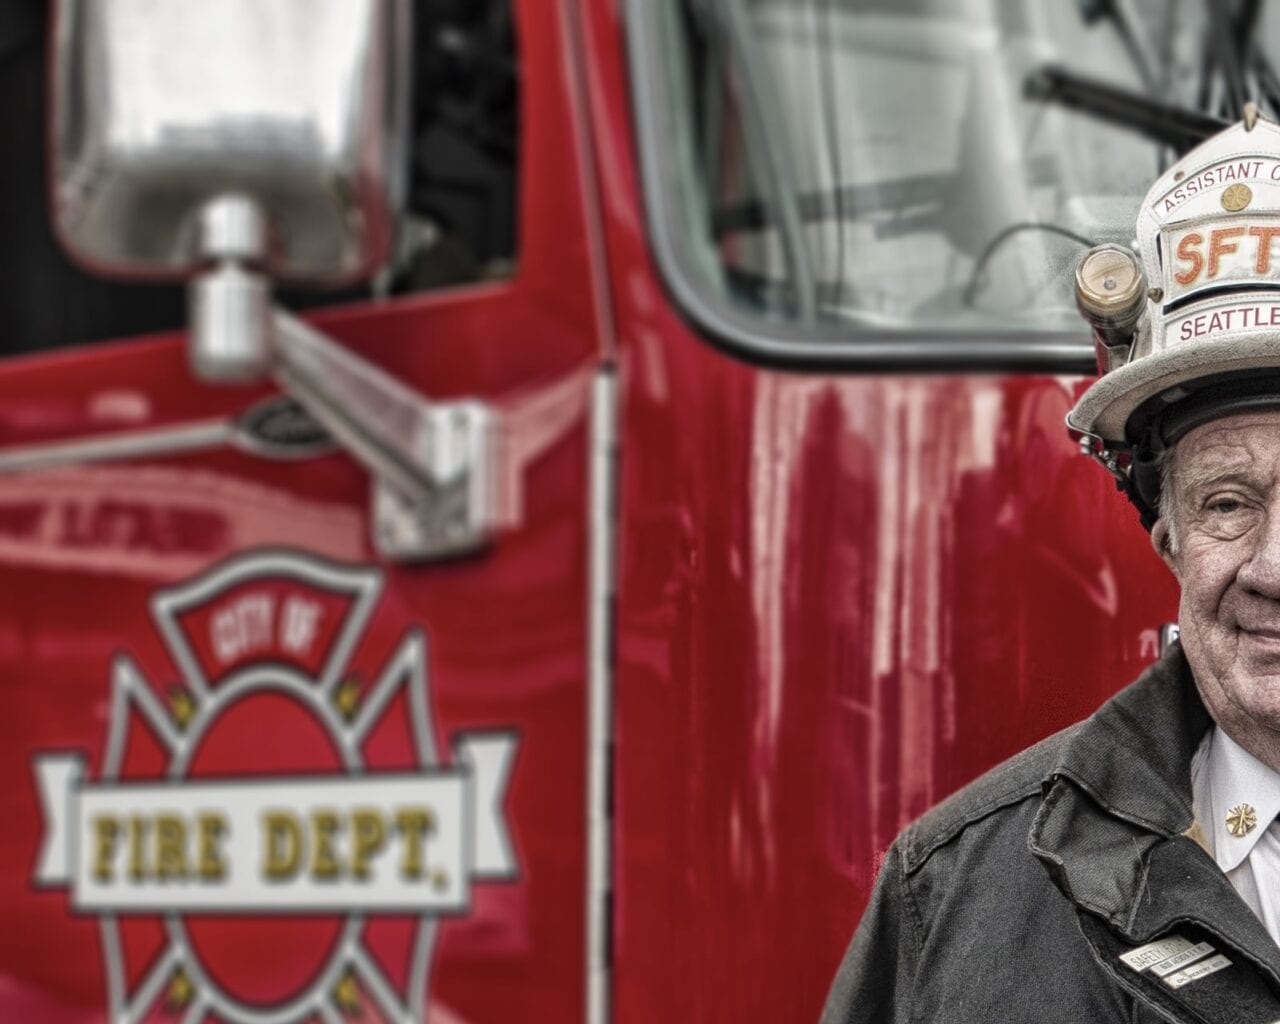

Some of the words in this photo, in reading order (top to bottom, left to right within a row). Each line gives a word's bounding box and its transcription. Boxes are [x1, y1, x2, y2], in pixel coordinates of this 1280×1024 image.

[1164, 161, 1264, 213] ASSISTANT
[90, 811, 231, 884] FIRE
[1130, 946, 1167, 968] SAFETY
